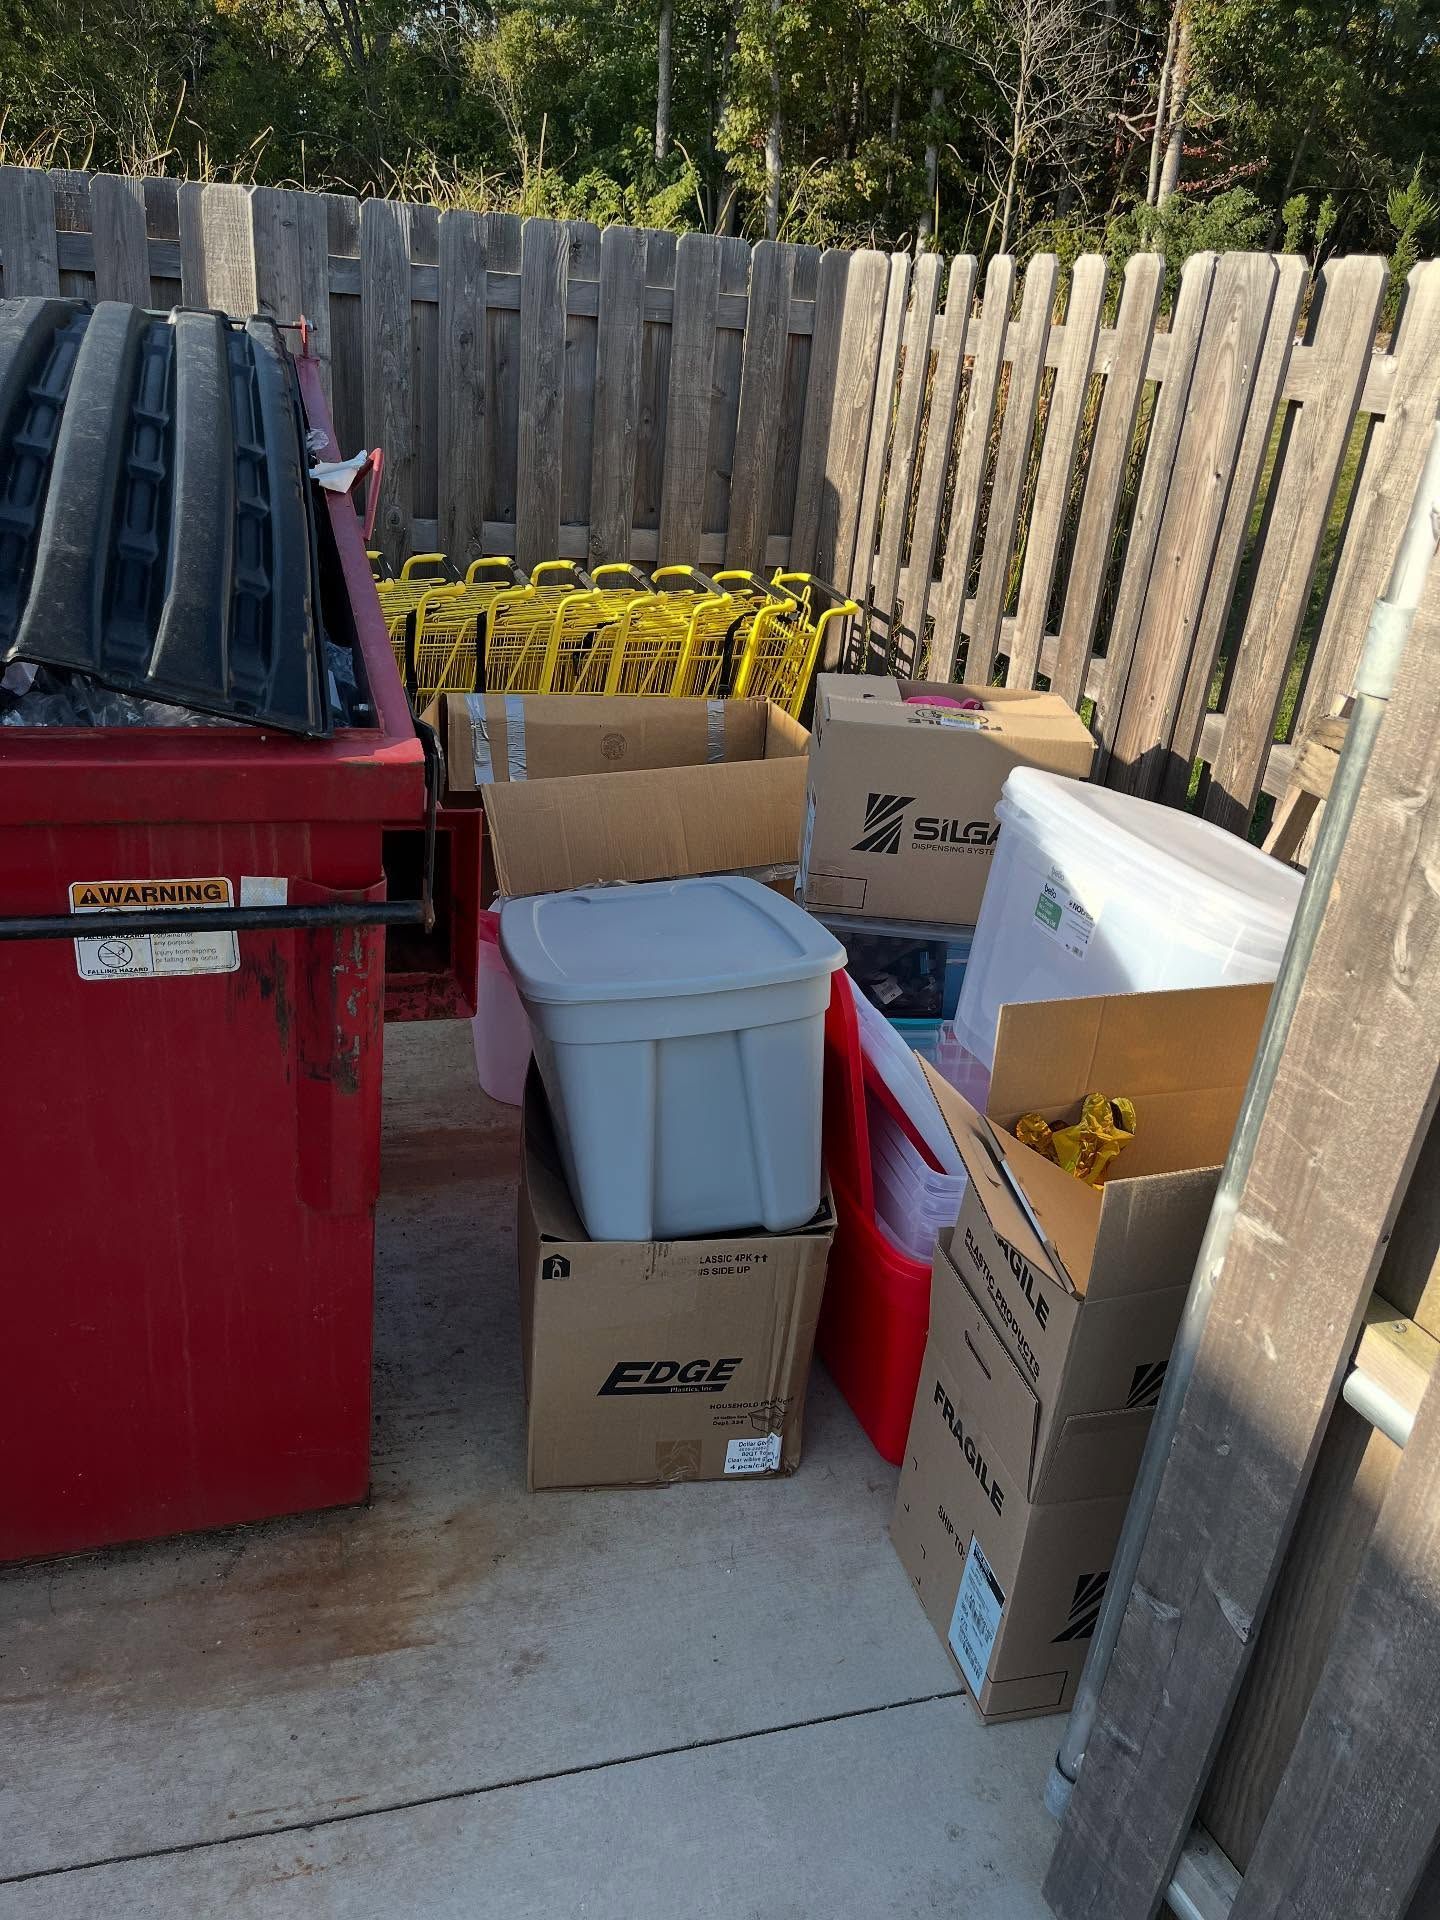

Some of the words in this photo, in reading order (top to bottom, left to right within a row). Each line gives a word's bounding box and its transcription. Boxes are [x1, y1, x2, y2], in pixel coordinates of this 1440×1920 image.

[914, 817, 1001, 846] SILGA
[912, 843, 965, 854] DISPENSING
[967, 847, 995, 856] SYSTE
[98, 884, 222, 904] WARNING
[699, 1254, 733, 1264] LASSIC
[734, 1253, 753, 1262] 4PK
[711, 1266, 735, 1275] SIDE
[736, 1265, 751, 1274] UP
[966, 1226, 995, 1290] PLASTIC
[995, 1288, 1040, 1378] PRODUCTS
[597, 1358, 744, 1396] EDGE
[709, 1401, 759, 1410] HOUSEHOLD
[933, 1379, 1005, 1517] FRAGILE
[938, 1504, 954, 1536] SHIP
